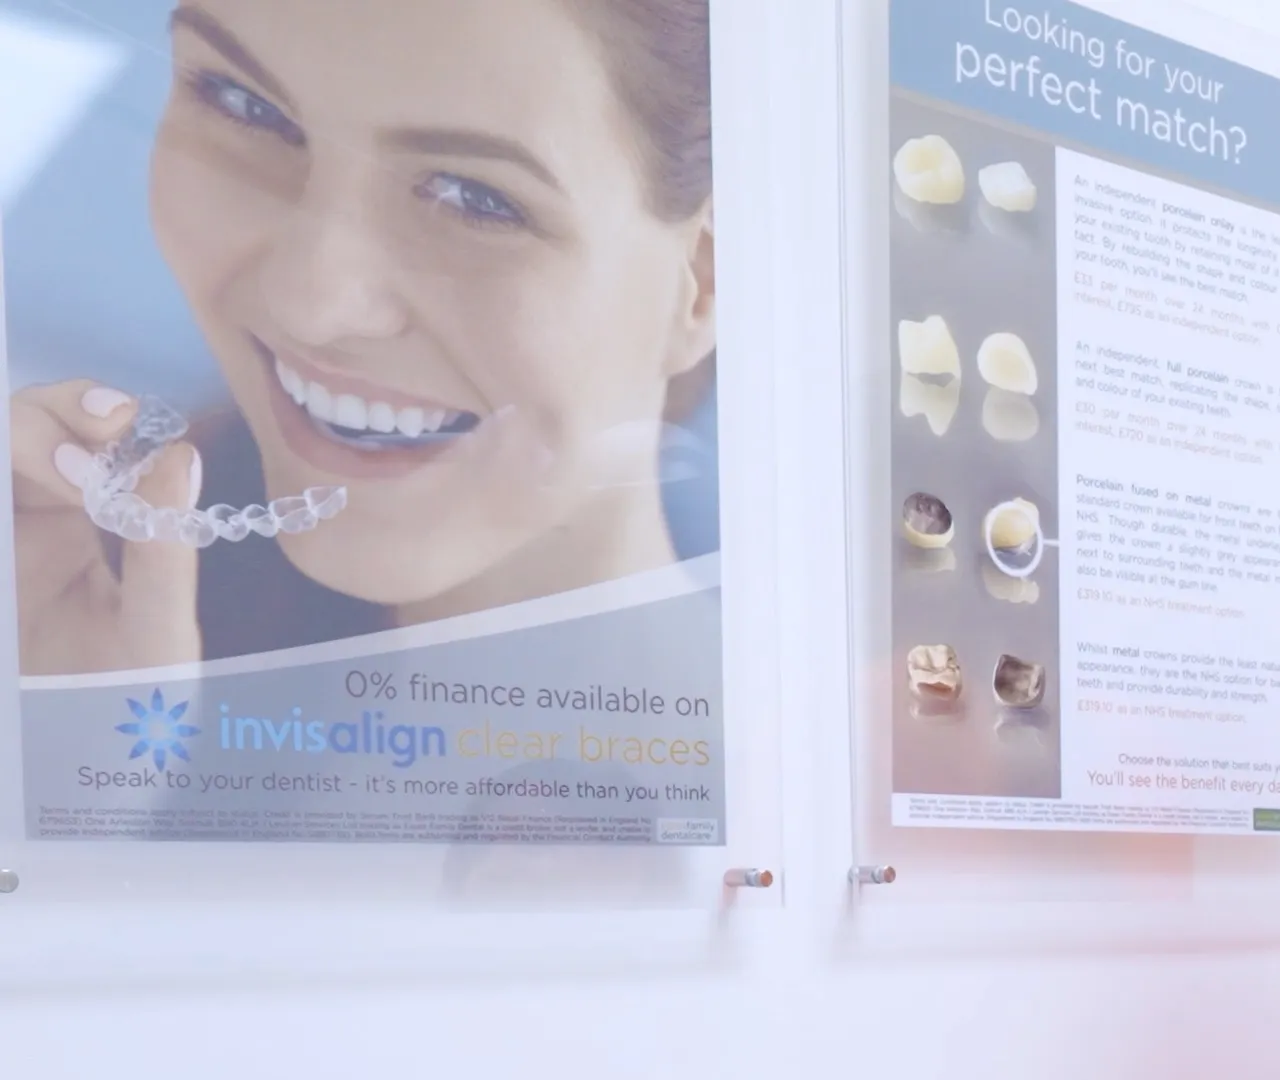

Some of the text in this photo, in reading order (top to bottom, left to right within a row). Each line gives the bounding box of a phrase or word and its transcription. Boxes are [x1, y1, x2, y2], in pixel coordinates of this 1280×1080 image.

[985, 0, 1224, 103] Looking for your
[956, 42, 1247, 164] perfect match?
[1075, 174, 1088, 187] An
[1162, 203, 1205, 223] porcelain
[1075, 213, 1096, 225] your
[1175, 238, 1185, 253] by
[1102, 236, 1116, 252] By
[1075, 250, 1097, 261] your
[1180, 274, 1194, 287] the
[1076, 340, 1089, 352] An
[1167, 361, 1182, 373] full
[1187, 368, 1229, 383] porcelain
[1075, 361, 1097, 372] next
[1103, 365, 1125, 378] best
[1170, 382, 1217, 401] replicating
[1076, 379, 1094, 389] and
[1097, 383, 1128, 396] colour
[1131, 389, 1141, 399] of
[1144, 393, 1165, 404] your
[1077, 474, 1123, 491] Porcelain
[1131, 484, 1158, 497] fused
[1165, 492, 1178, 500] on
[1185, 495, 1211, 506] metal
[1218, 501, 1250, 512] crowns
[1077, 494, 1120, 509] standard
[1123, 503, 1152, 514] crown
[1156, 508, 1196, 520] available
[1199, 512, 1211, 523] for
[1215, 515, 1235, 526] front
[1264, 525, 1275, 533] on
[1109, 515, 1144, 531] Though
[1195, 528, 1210, 539] the
[1214, 533, 1240, 544] metal
[1077, 530, 1102, 542] gives
[1109, 534, 1125, 545] the
[1131, 540, 1161, 550] crown
[1179, 544, 1210, 560] slightly
[1217, 552, 1237, 564] grey
[1077, 549, 1098, 559] next
[1103, 550, 1113, 561] to
[1119, 555, 1175, 572] surrounding
[1180, 561, 1203, 573] teeth
[1207, 566, 1224, 575] and
[1228, 567, 1242, 578] the
[1247, 571, 1270, 582] metal
[1077, 565, 1097, 576] also
[1100, 568, 1112, 578] be
[1116, 570, 1144, 582] visible
[1161, 575, 1176, 586] the
[1178, 580, 1199, 591] gum
[1077, 642, 1107, 654] Whilst
[1112, 647, 1139, 658] metal
[1144, 652, 1177, 661] crowns
[1181, 654, 1215, 665] provide
[1219, 656, 1233, 667] the
[1077, 677, 1102, 689] teeth
[1106, 681, 1124, 690] and
[1127, 683, 1163, 695] provide
[1166, 685, 1209, 701] durability
[1211, 689, 1227, 699] and
[1140, 666, 1160, 680] they
[1182, 670, 1197, 680] the
[1201, 671, 1220, 682] NHS
[1224, 674, 1251, 687] option
[1255, 676, 1267, 686] for
[345, 670, 710, 717] 0% finance available on
[1145, 704, 1165, 716] NHS
[1169, 706, 1212, 720] treatment
[219, 704, 710, 768] invisalign clear braces
[1118, 754, 1153, 765] Choose
[1157, 756, 1171, 767] the
[1174, 757, 1209, 769] solution
[1253, 762, 1272, 772] suits
[78, 766, 156, 790] Speak
[166, 768, 191, 789] to
[200, 774, 253, 793] your
[262, 772, 342, 792] dentist
[366, 774, 396, 794] it's
[404, 778, 458, 796] more
[466, 778, 570, 798] affordable
[576, 781, 619, 800] than
[624, 784, 658, 802] you
[666, 784, 710, 802] think
[1087, 770, 1124, 786] You'll
[1129, 775, 1151, 788] see
[1156, 774, 1177, 789] the
[1182, 775, 1226, 791] benefit
[1231, 779, 1263, 795] every
[39, 806, 148, 816] Terms and conditions
[40, 828, 80, 838] provide
[82, 828, 145, 838] independent
[661, 831, 712, 840] dentalcare
